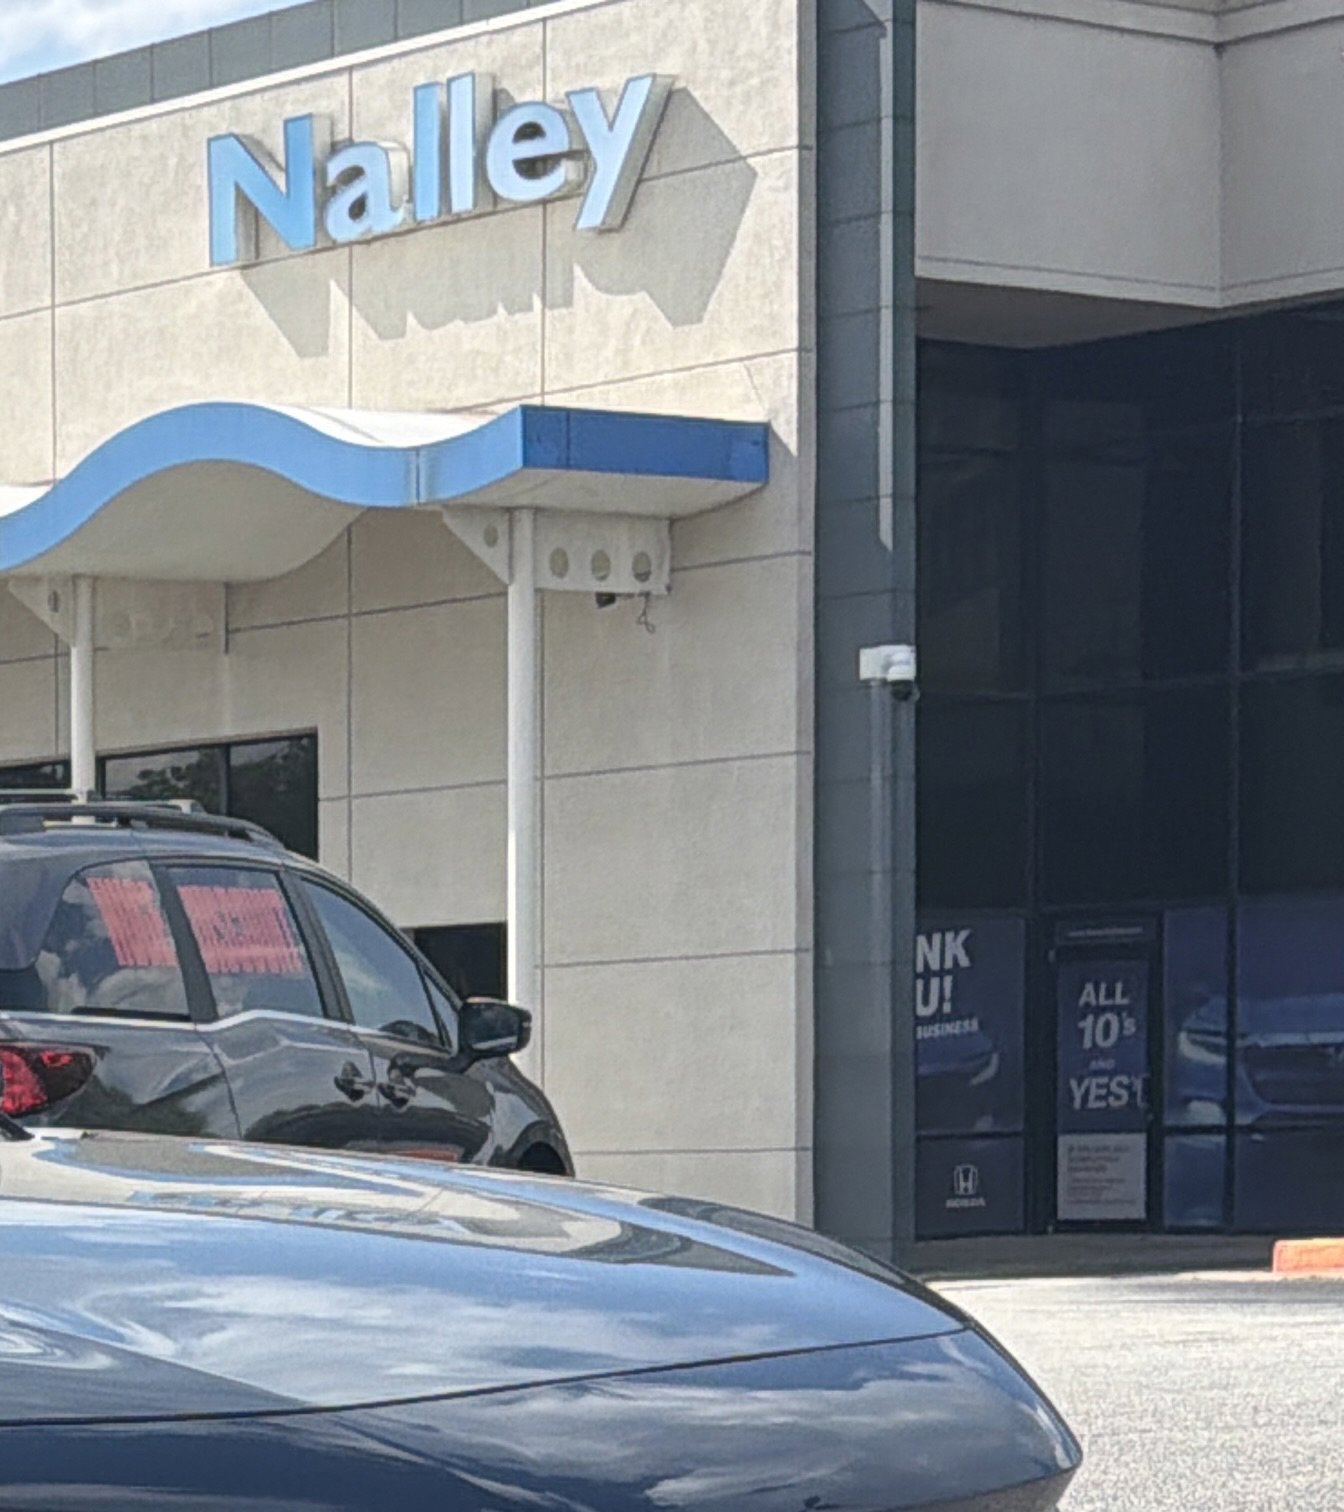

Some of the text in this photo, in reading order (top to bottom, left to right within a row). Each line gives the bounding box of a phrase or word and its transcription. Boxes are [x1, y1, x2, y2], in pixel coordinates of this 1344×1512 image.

[206, 72, 657, 268] Nalley
[1078, 981, 1131, 1007] ALL
[1077, 1012, 1138, 1050] 10's
